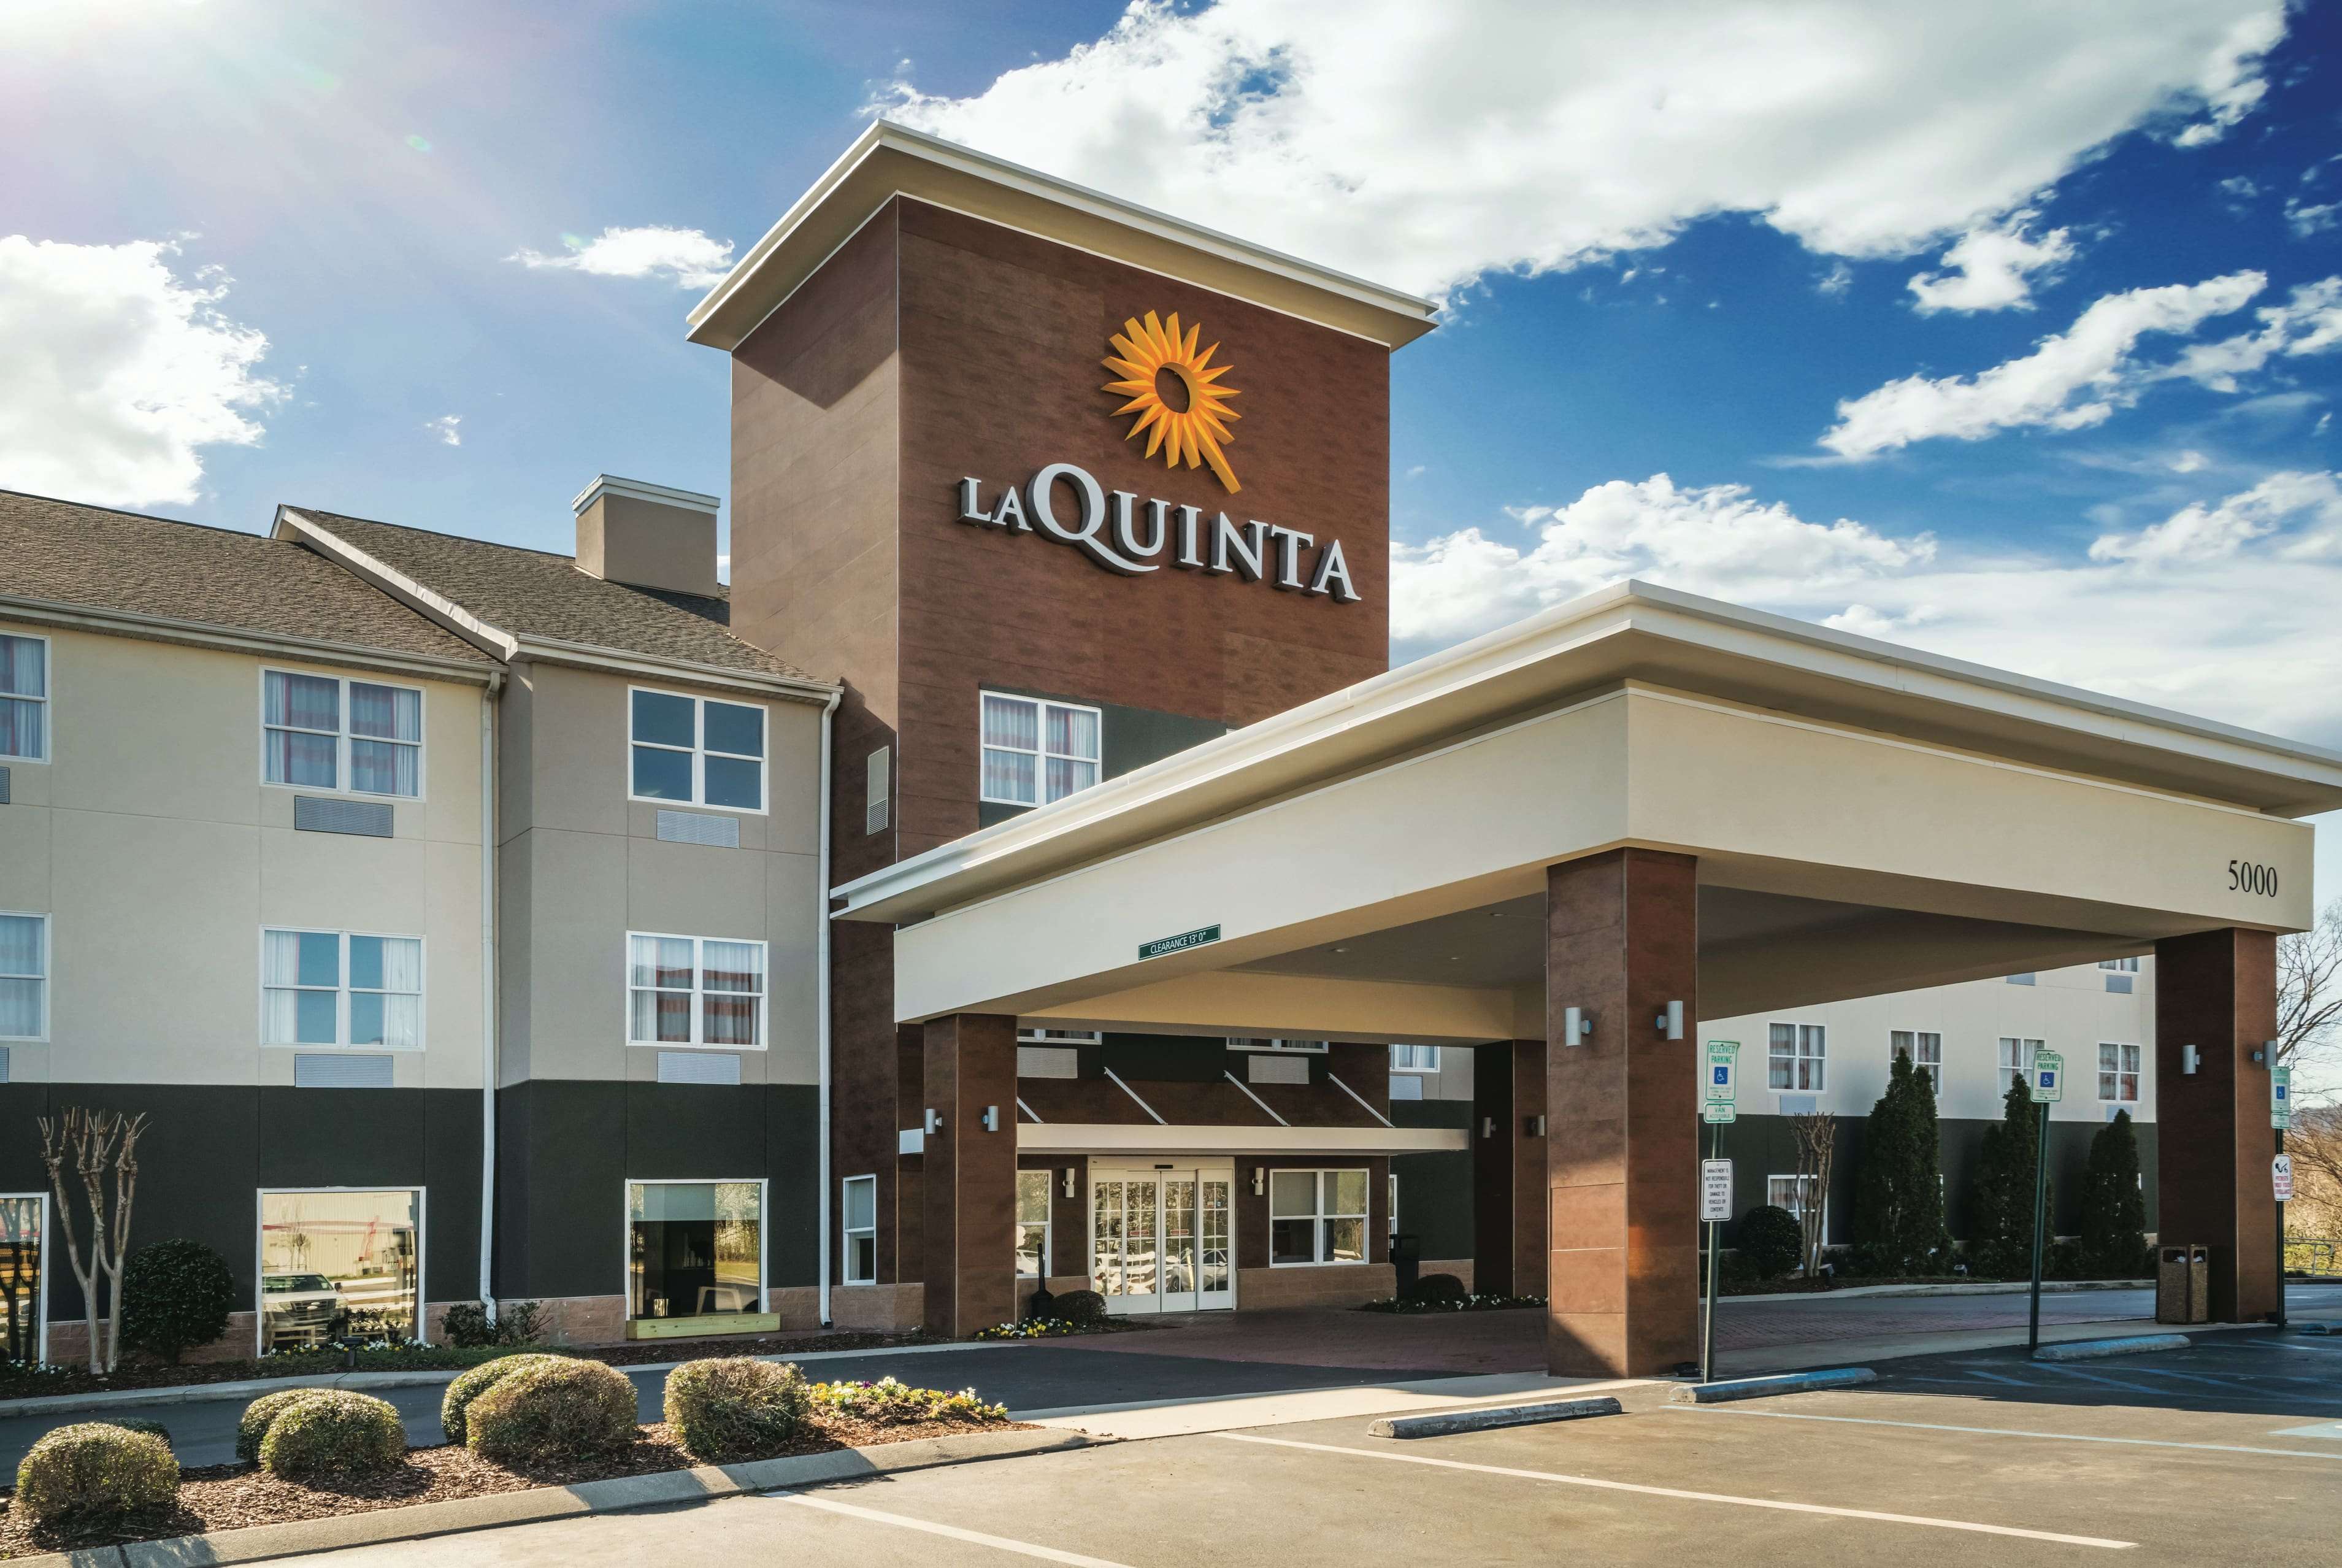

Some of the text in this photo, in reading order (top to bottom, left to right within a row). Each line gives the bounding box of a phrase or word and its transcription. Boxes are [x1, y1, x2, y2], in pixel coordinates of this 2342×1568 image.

[1026, 463, 1362, 604] QUINTA
[2229, 860, 2278, 897] 5000
[1150, 937, 1187, 954] CLEARANCE
[1189, 934, 1197, 944] 13'
[1709, 1045, 1736, 1053] RESERVED
[1711, 1055, 1732, 1064] PARKING
